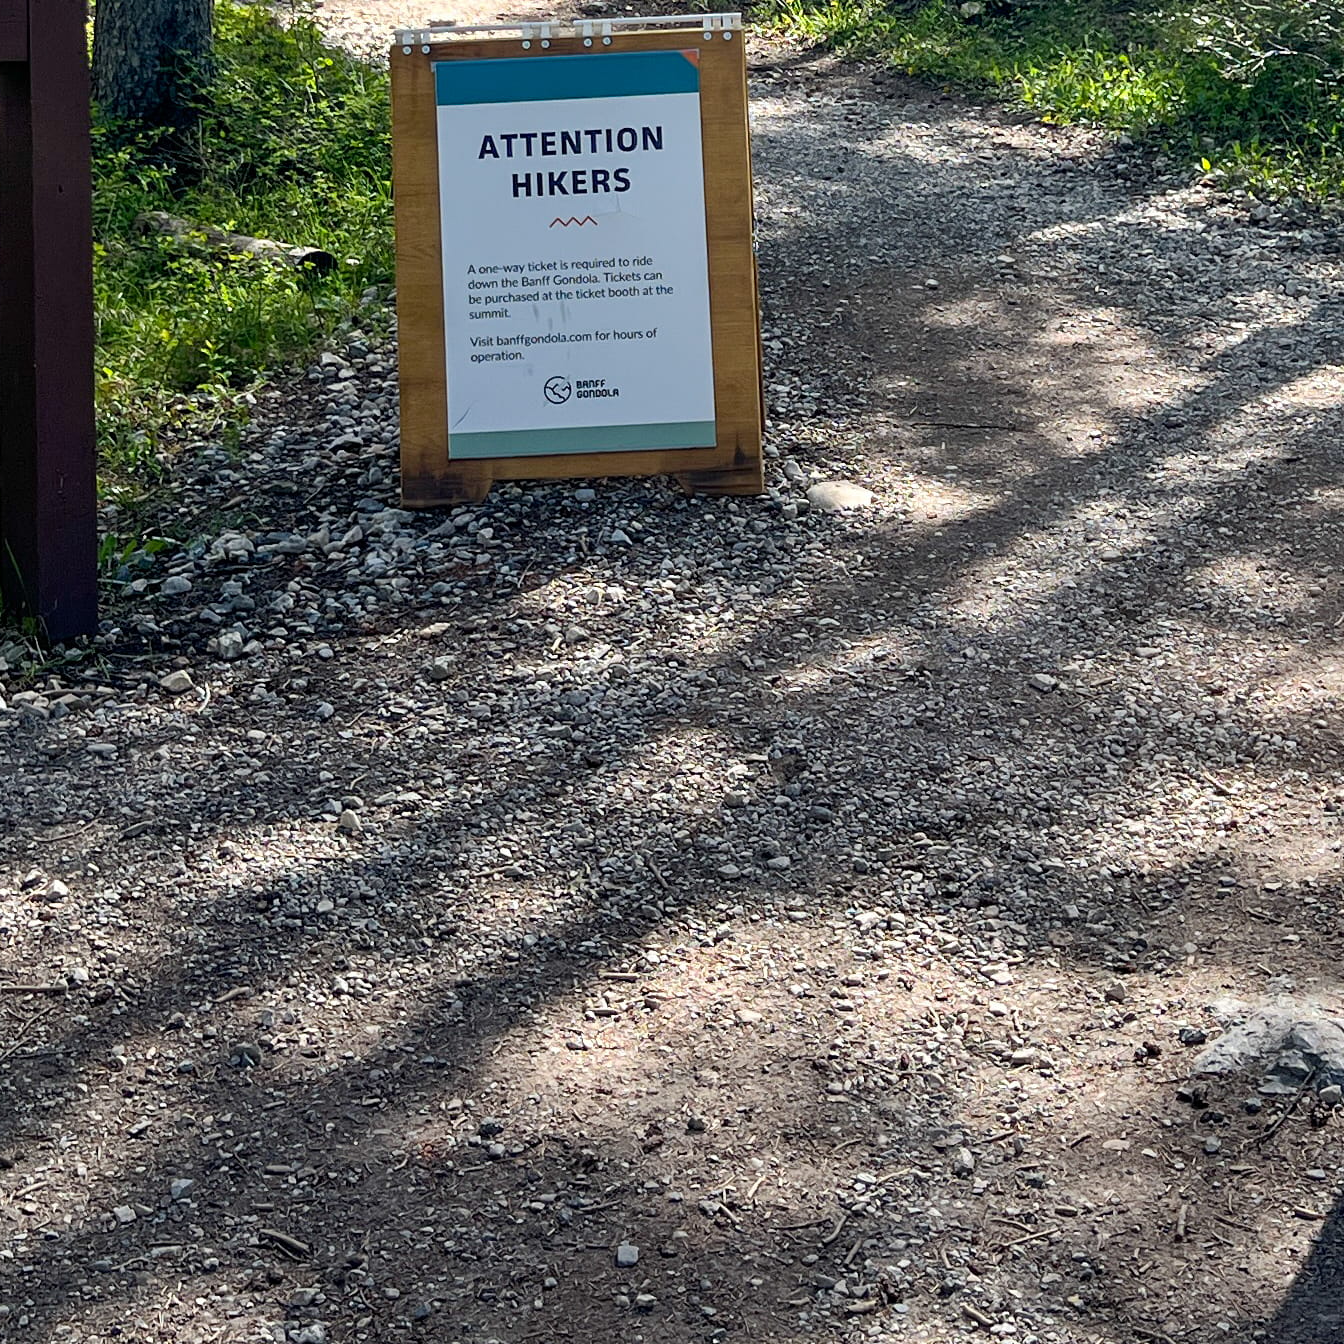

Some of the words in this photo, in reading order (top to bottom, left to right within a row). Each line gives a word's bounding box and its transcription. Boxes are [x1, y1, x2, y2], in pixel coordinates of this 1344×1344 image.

[478, 126, 663, 159] ATTENTION
[512, 167, 631, 198] HIKERS
[467, 264, 476, 274] A
[478, 264, 525, 274] one-way
[528, 261, 557, 272] ticket
[560, 260, 568, 270] is
[571, 258, 615, 270] required
[618, 258, 629, 267] to
[632, 256, 653, 266] ride
[468, 280, 498, 289] down
[501, 277, 518, 288] the
[521, 276, 550, 287] Banff
[553, 274, 600, 285] Gondola.
[604, 272, 641, 283] Tickets
[644, 272, 663, 281] can
[468, 295, 482, 304] be
[485, 291, 540, 305] purchased
[542, 291, 553, 301] at
[555, 290, 573, 300] the
[576, 288, 606, 299] ticket
[608, 286, 640, 297] booth
[643, 286, 654, 296] at
[656, 285, 674, 295] the
[469, 308, 511, 319] summit.
[470, 336, 494, 346] Visit
[497, 333, 592, 347] banffgondola.com
[595, 331, 610, 341] for
[613, 330, 643, 340] hours
[646, 328, 658, 338] of
[470, 351, 525, 363] operation.
[576, 379, 606, 389] BANFF
[576, 388, 619, 398] GONDOLA
